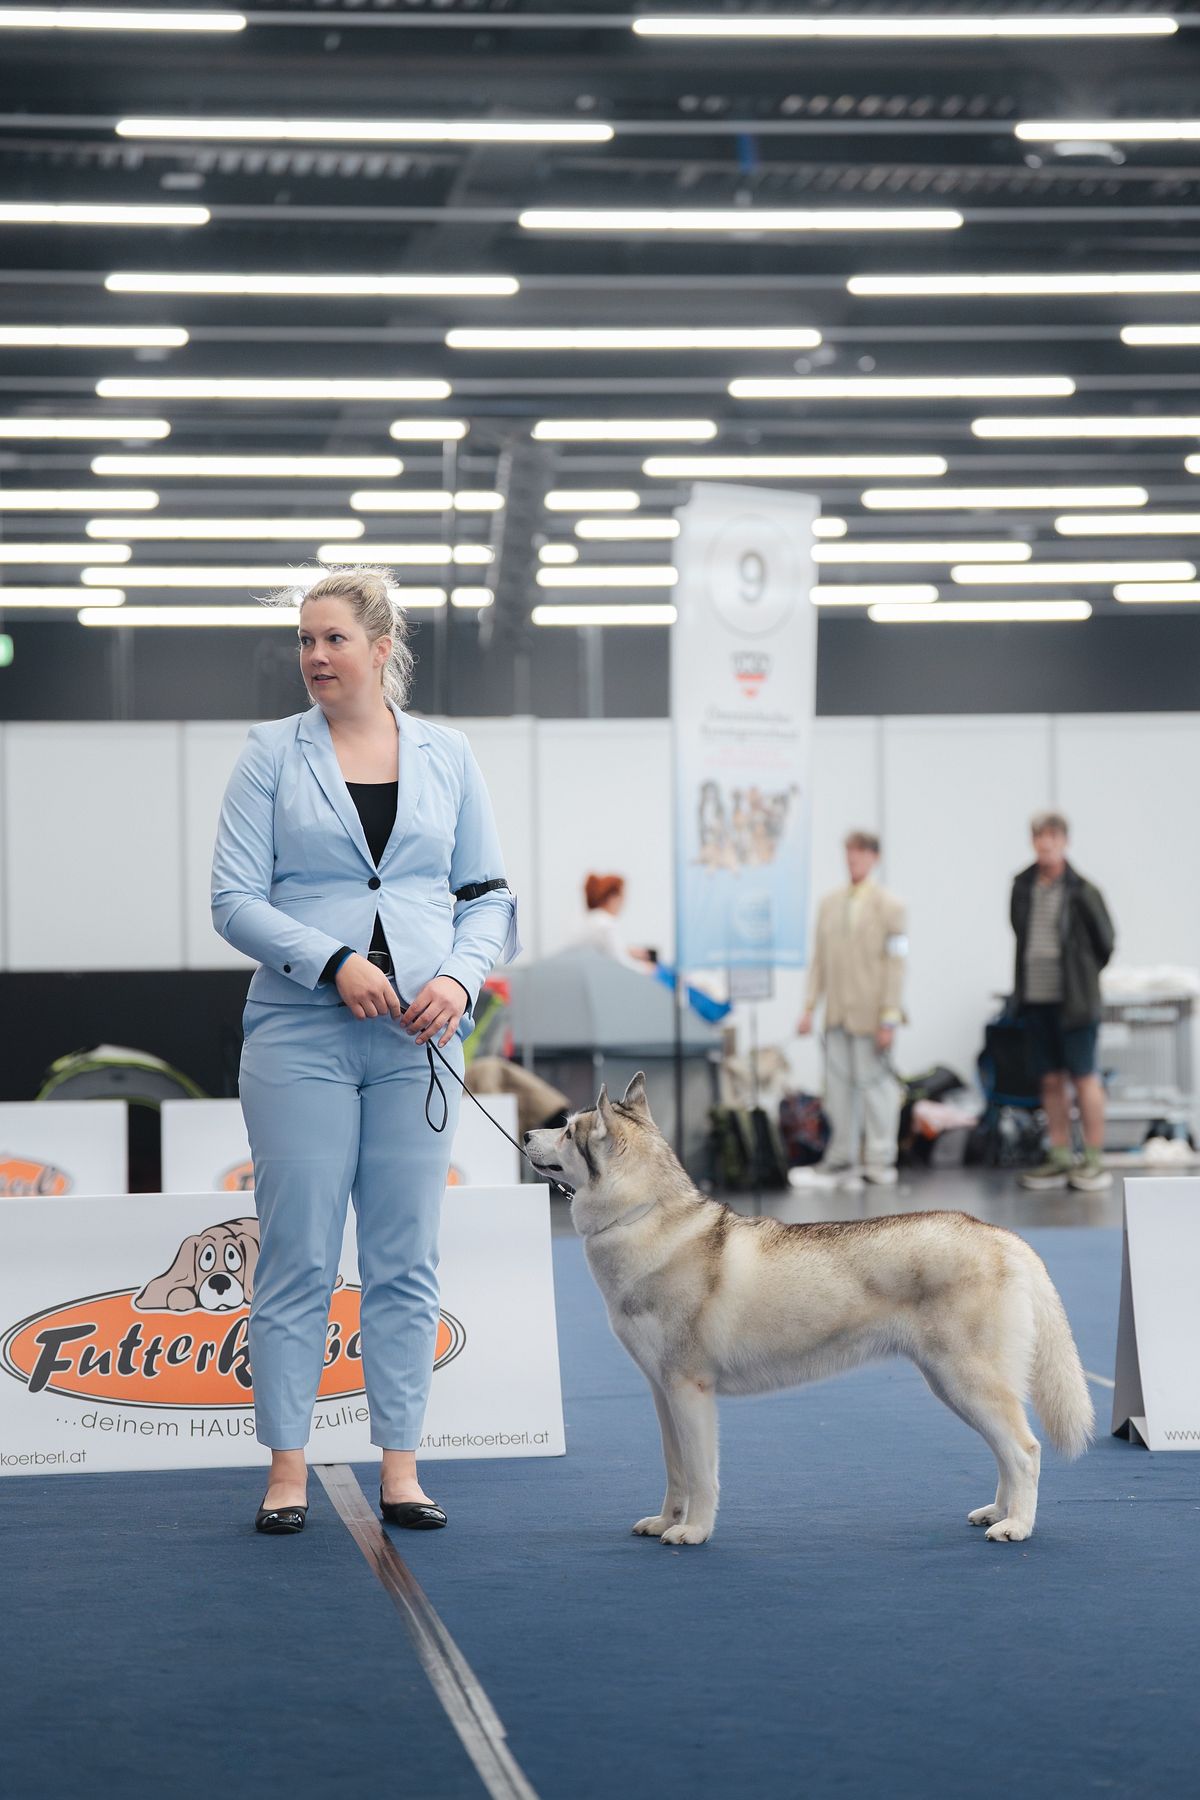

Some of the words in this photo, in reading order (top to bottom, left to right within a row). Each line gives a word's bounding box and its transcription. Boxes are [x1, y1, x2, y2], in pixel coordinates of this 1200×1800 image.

[738, 548, 768, 607] 9
[28, 1316, 362, 1393] Futterkbe
[190, 1417, 256, 1437] HAUS
[313, 1406, 370, 1430] zulie
[419, 1430, 550, 1448] .futterkoerberl.at
